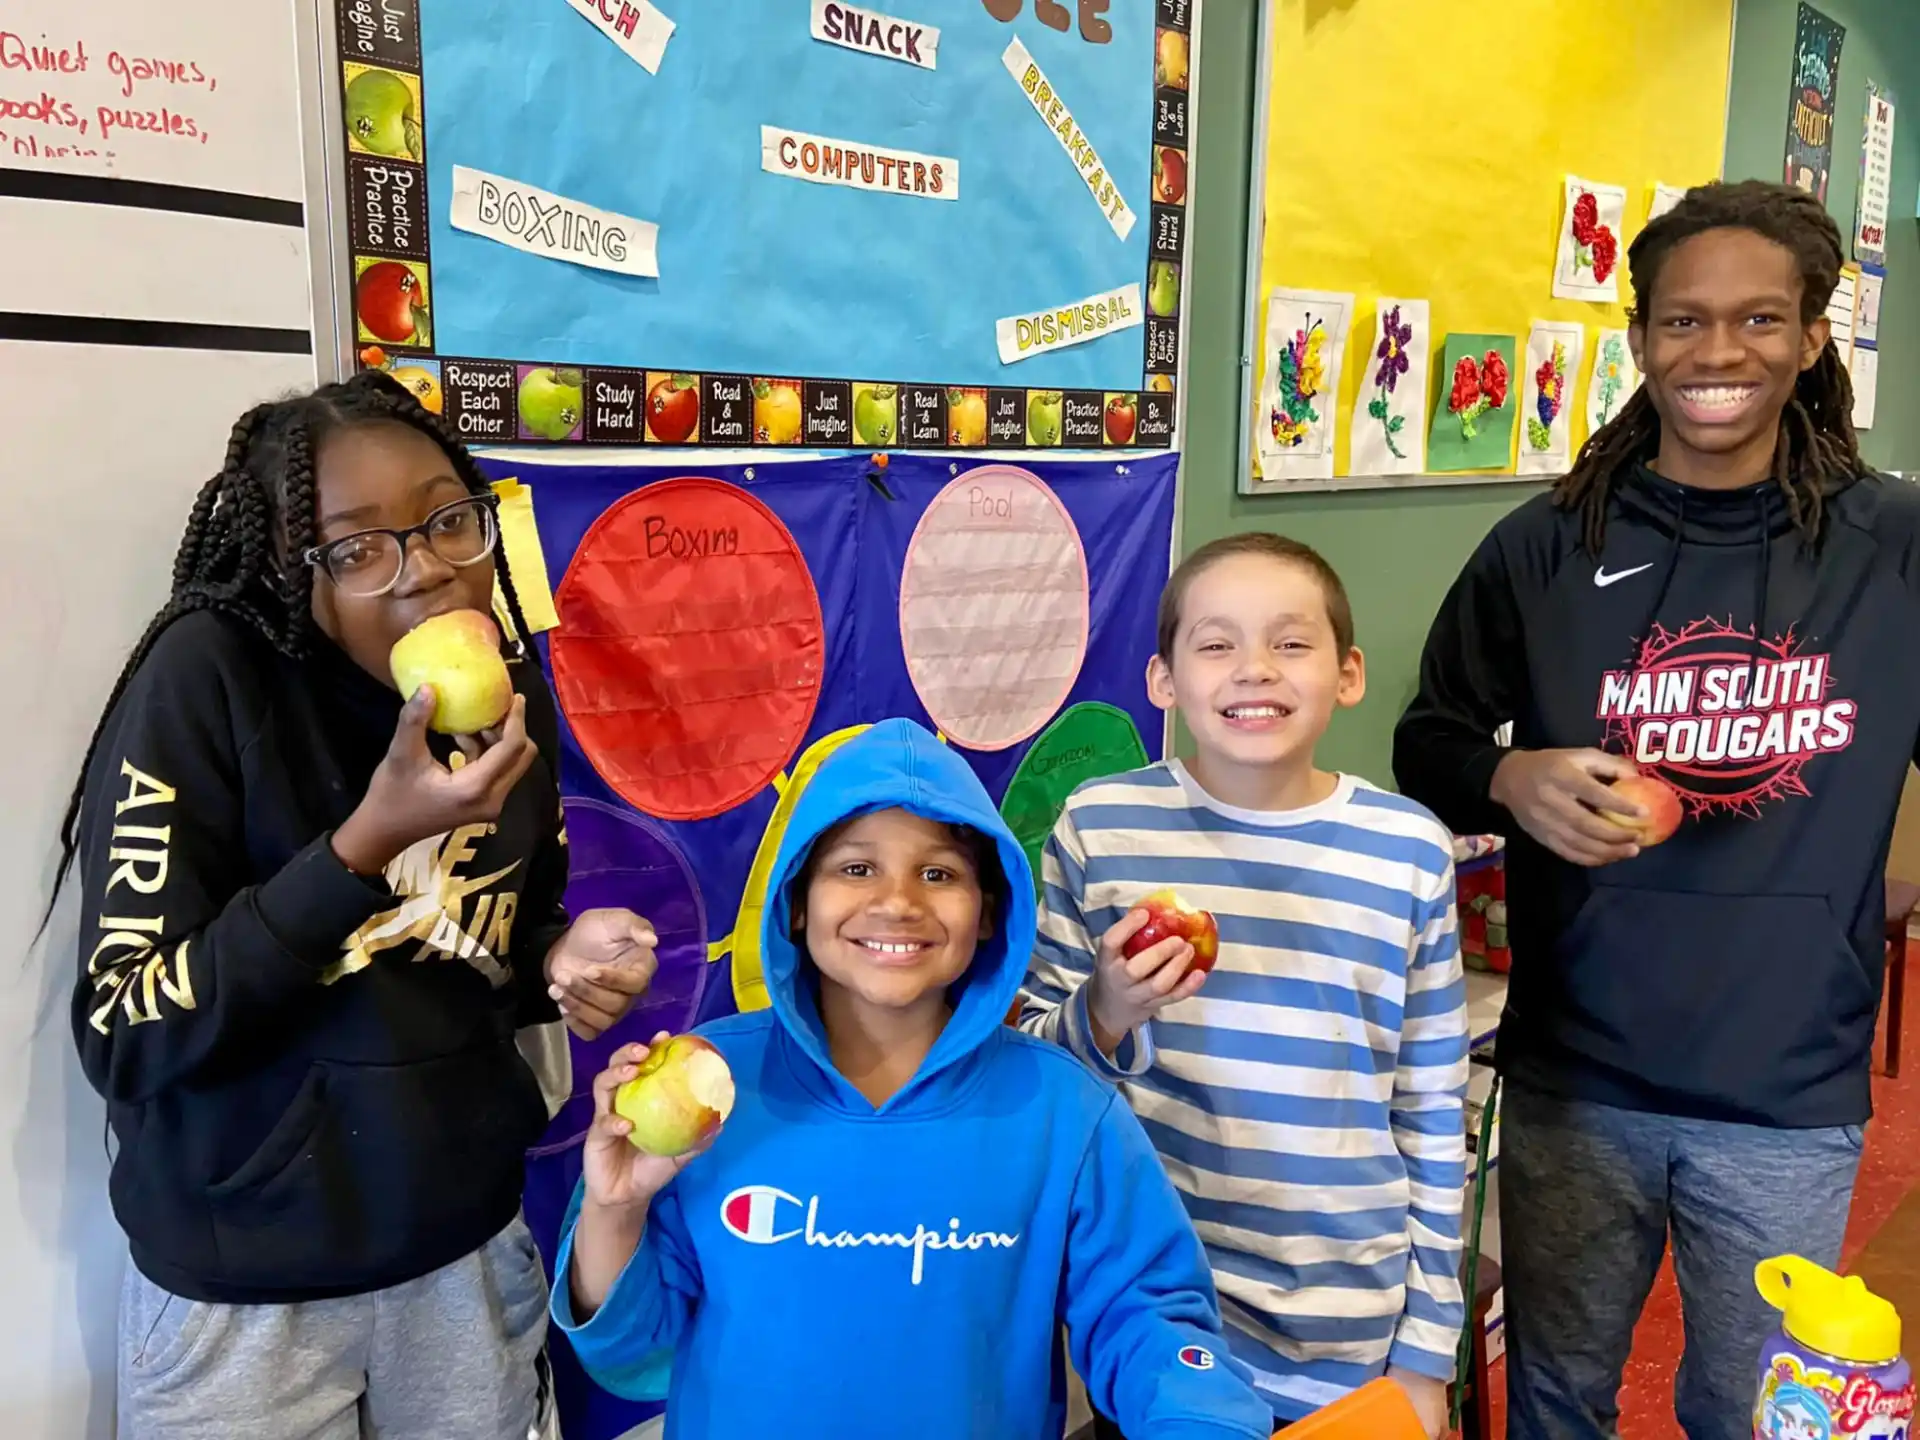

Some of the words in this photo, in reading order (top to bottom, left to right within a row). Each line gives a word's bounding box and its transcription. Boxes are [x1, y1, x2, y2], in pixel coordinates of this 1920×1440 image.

[347, 0, 376, 52] agine
[380, 0, 406, 43] Just
[823, 3, 923, 63] SNACK
[0, 31, 88, 71] Quiet
[108, 51, 217, 97] games,
[97, 106, 208, 144] puzzles,
[1157, 100, 1169, 132] Read
[1174, 102, 1185, 137] Learn
[1021, 63, 1125, 220] BREAKFAST
[779, 136, 944, 193] COMPUTERS
[363, 166, 388, 245] Practice
[389, 169, 414, 248] Practice
[478, 180, 627, 262] BOXING
[1157, 213, 1171, 250] Study
[1167, 215, 1180, 250] Hard
[1015, 296, 1131, 351] DISMISSAL
[1147, 320, 1158, 369] Respect
[1157, 330, 1167, 361] Each
[1165, 328, 1176, 364] Other
[447, 366, 512, 389] Respect
[712, 381, 742, 401] Read
[460, 391, 501, 411] Each
[596, 382, 635, 409] Study
[722, 402, 732, 419] &
[815, 390, 839, 411] Just
[913, 391, 938, 409] Read
[996, 397, 1016, 417] Just
[1066, 399, 1100, 417] Practice
[1148, 402, 1160, 418] Be
[458, 412, 504, 434] Other
[596, 406, 634, 429] Hard
[711, 416, 743, 436] Learn
[807, 412, 847, 438] Imagine
[912, 422, 940, 440] Learn
[921, 410, 930, 424] &
[990, 418, 1022, 441] Imagine
[1065, 418, 1100, 436] Practice
[1138, 419, 1169, 436] Creative
[968, 486, 1013, 519] Pool
[643, 515, 739, 562] Boxing
[1598, 669, 1695, 716] MAIN
[1698, 657, 1827, 713] SOUTH
[1634, 702, 1854, 764] COUGARS
[105, 756, 177, 898] AIR
[719, 1184, 1020, 1285] Champion
